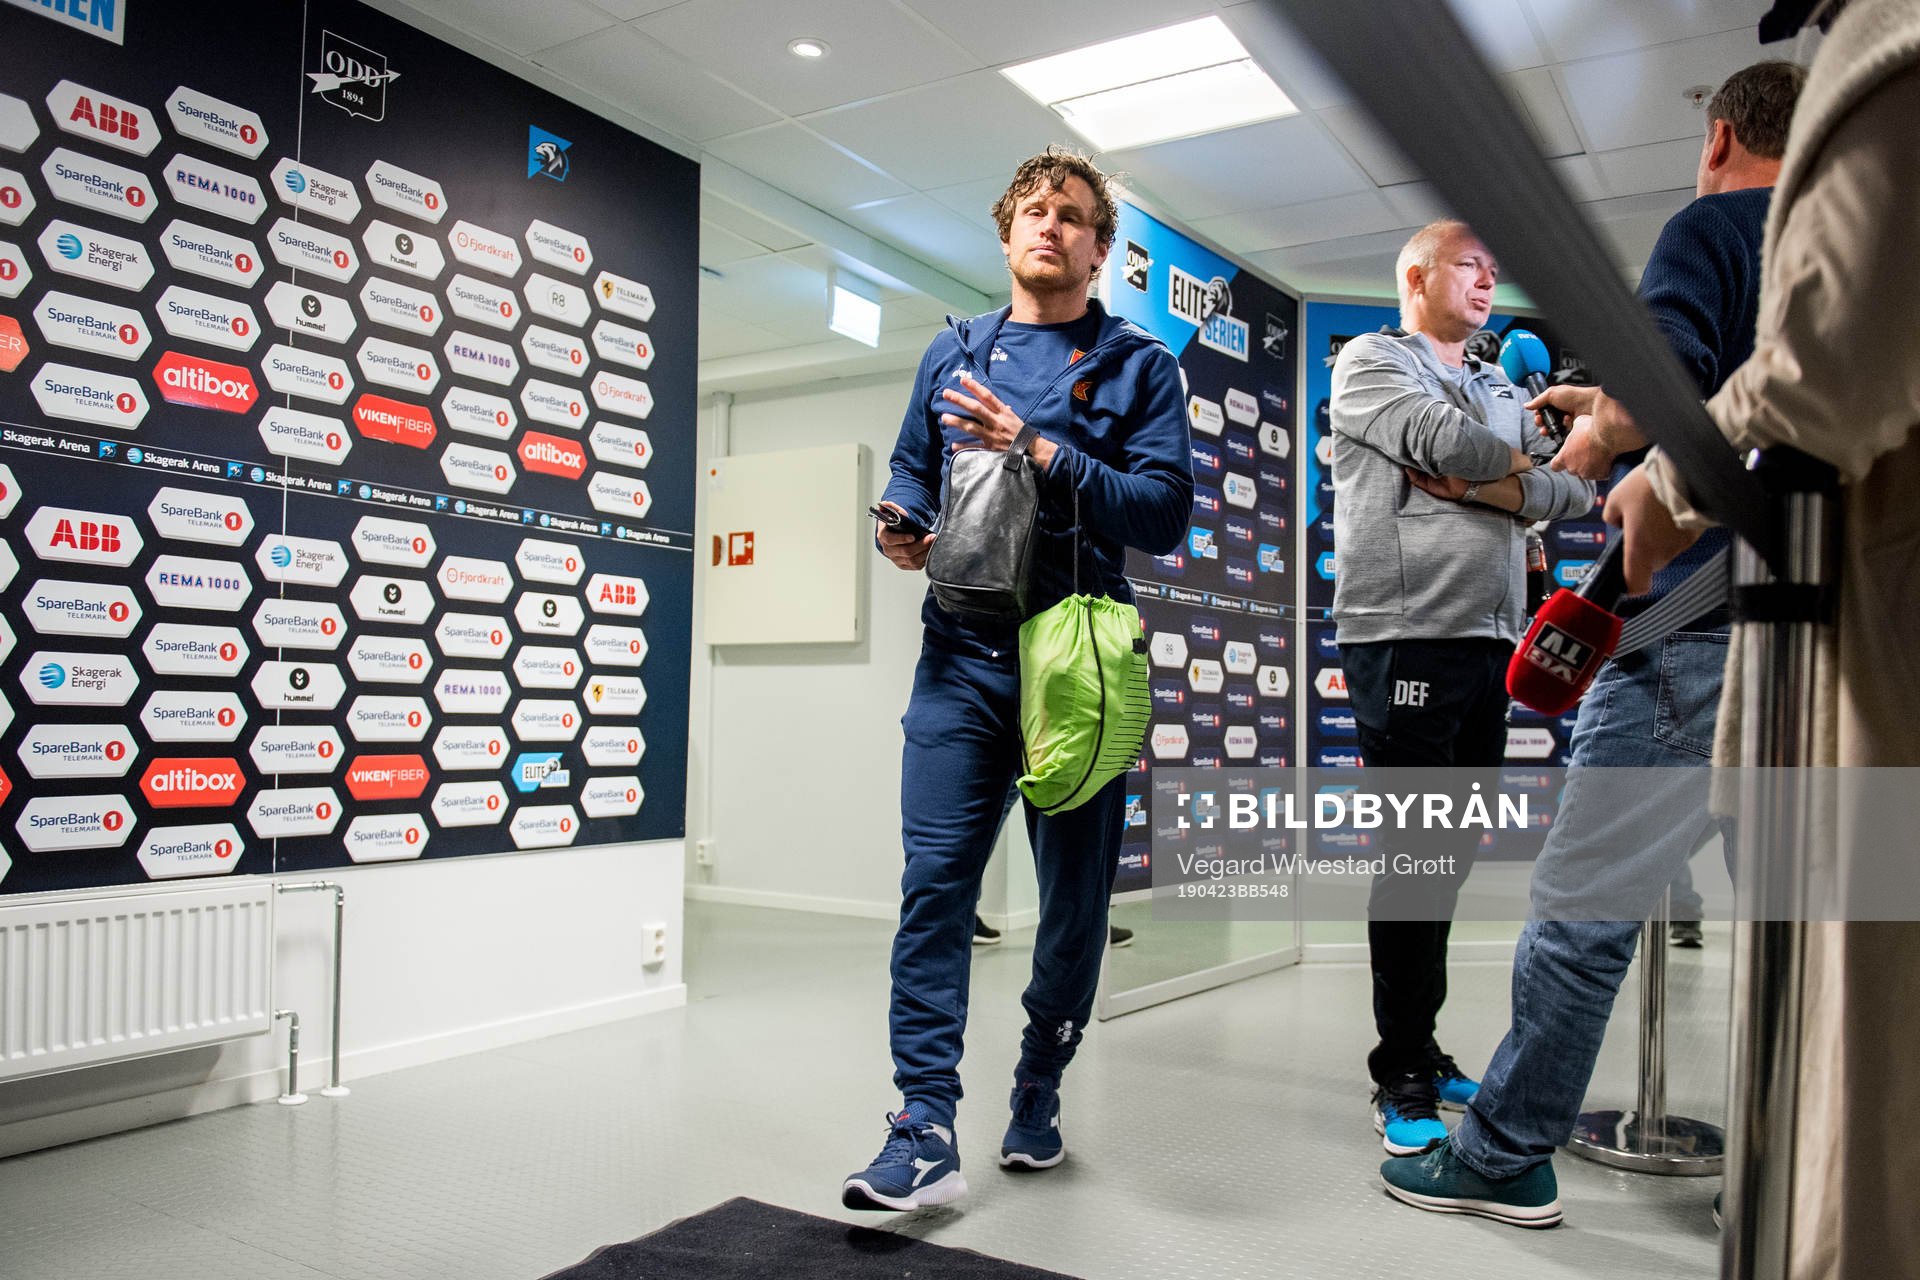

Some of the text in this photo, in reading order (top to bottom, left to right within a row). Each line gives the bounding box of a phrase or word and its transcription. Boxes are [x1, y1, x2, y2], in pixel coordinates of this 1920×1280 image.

[326, 50, 381, 88] ODD
[342, 89, 365, 106] 1894
[69, 94, 139, 140] ABB
[178, 100, 237, 131] SpareBank
[204, 122, 238, 139] TELEMARK
[55, 163, 123, 193] SpareBank
[177, 169, 255, 205] REMA 1000
[375, 173, 423, 198] SpareBank
[85, 185, 124, 202] TELEMARK
[309, 187, 336, 205] Energi
[310, 178, 348, 198] Skagerak
[88, 241, 137, 263] Skagerak
[172, 234, 233, 261] SpareBank
[278, 231, 332, 257] SpareBank
[469, 237, 513, 261] Fjordkraft
[88, 252, 122, 271] Energi
[199, 254, 233, 268] TELEMARK
[390, 253, 417, 269] hummel
[369, 290, 418, 312] SpareBank
[455, 286, 498, 308] SpareBank
[551, 290, 565, 308] R8
[1173, 273, 1208, 322] ELITE
[46, 306, 116, 332] SpareBank
[168, 300, 229, 324] SpareBank
[195, 319, 229, 332] TELEMARK
[295, 316, 325, 332] hummel
[77, 327, 116, 341] TELEMARK
[1204, 316, 1246, 354] SERIEN
[366, 350, 415, 370] SpareBank
[453, 344, 510, 369] REMA 1000
[272, 358, 326, 379] SpareBank
[44, 379, 114, 402] SpareBank
[163, 365, 250, 402] altibox
[75, 397, 114, 410] TELEMARK
[450, 399, 494, 417] SpareBank
[358, 407, 432, 435] VIKENFIBER
[269, 421, 324, 440] SpareBank
[3, 430, 91, 453] Skagerak Arena
[144, 452, 220, 473] Skagerak Arena
[449, 455, 493, 472] SpareBank
[524, 441, 581, 468] altibox
[265, 471, 332, 491] Skagerak Arena
[371, 488, 431, 507] Skagerak Arena
[160, 502, 222, 521] SpareBank
[187, 519, 223, 529] TELEMARK
[48, 518, 121, 554] ABB
[361, 530, 411, 545] SpareBank
[296, 549, 335, 562] Skagerak
[295, 558, 323, 572] Energi
[159, 572, 240, 591] REMA 1000
[459, 570, 503, 585] Fjordkraft
[598, 581, 637, 607] ABB
[35, 596, 106, 612] SpareBank
[67, 612, 107, 620] TELEMARK
[263, 613, 319, 626] SpareBank
[444, 626, 489, 638] SpareBank
[155, 639, 217, 652] SpareBank
[1540, 630, 1581, 665] TV
[358, 649, 407, 661] SpareBank
[71, 666, 122, 679] Skagerak
[71, 677, 106, 690] Energi
[444, 683, 502, 696] REMA 1000
[283, 693, 314, 703] hummel
[1394, 679, 1430, 707] DEF
[153, 707, 215, 720] SpareBank
[356, 709, 406, 721] SpareBank
[31, 740, 102, 755] SpareBank
[260, 740, 316, 753] SpareBank
[150, 768, 237, 791] altibox
[351, 769, 425, 788] VIKENFIBER
[258, 802, 313, 817] SpareBank
[29, 811, 100, 828] SpareBank
[61, 825, 101, 833] TELEMARK
[354, 828, 403, 842] SpareBank
[149, 840, 212, 856] SpareBank
[177, 852, 212, 861] TELEMARK
